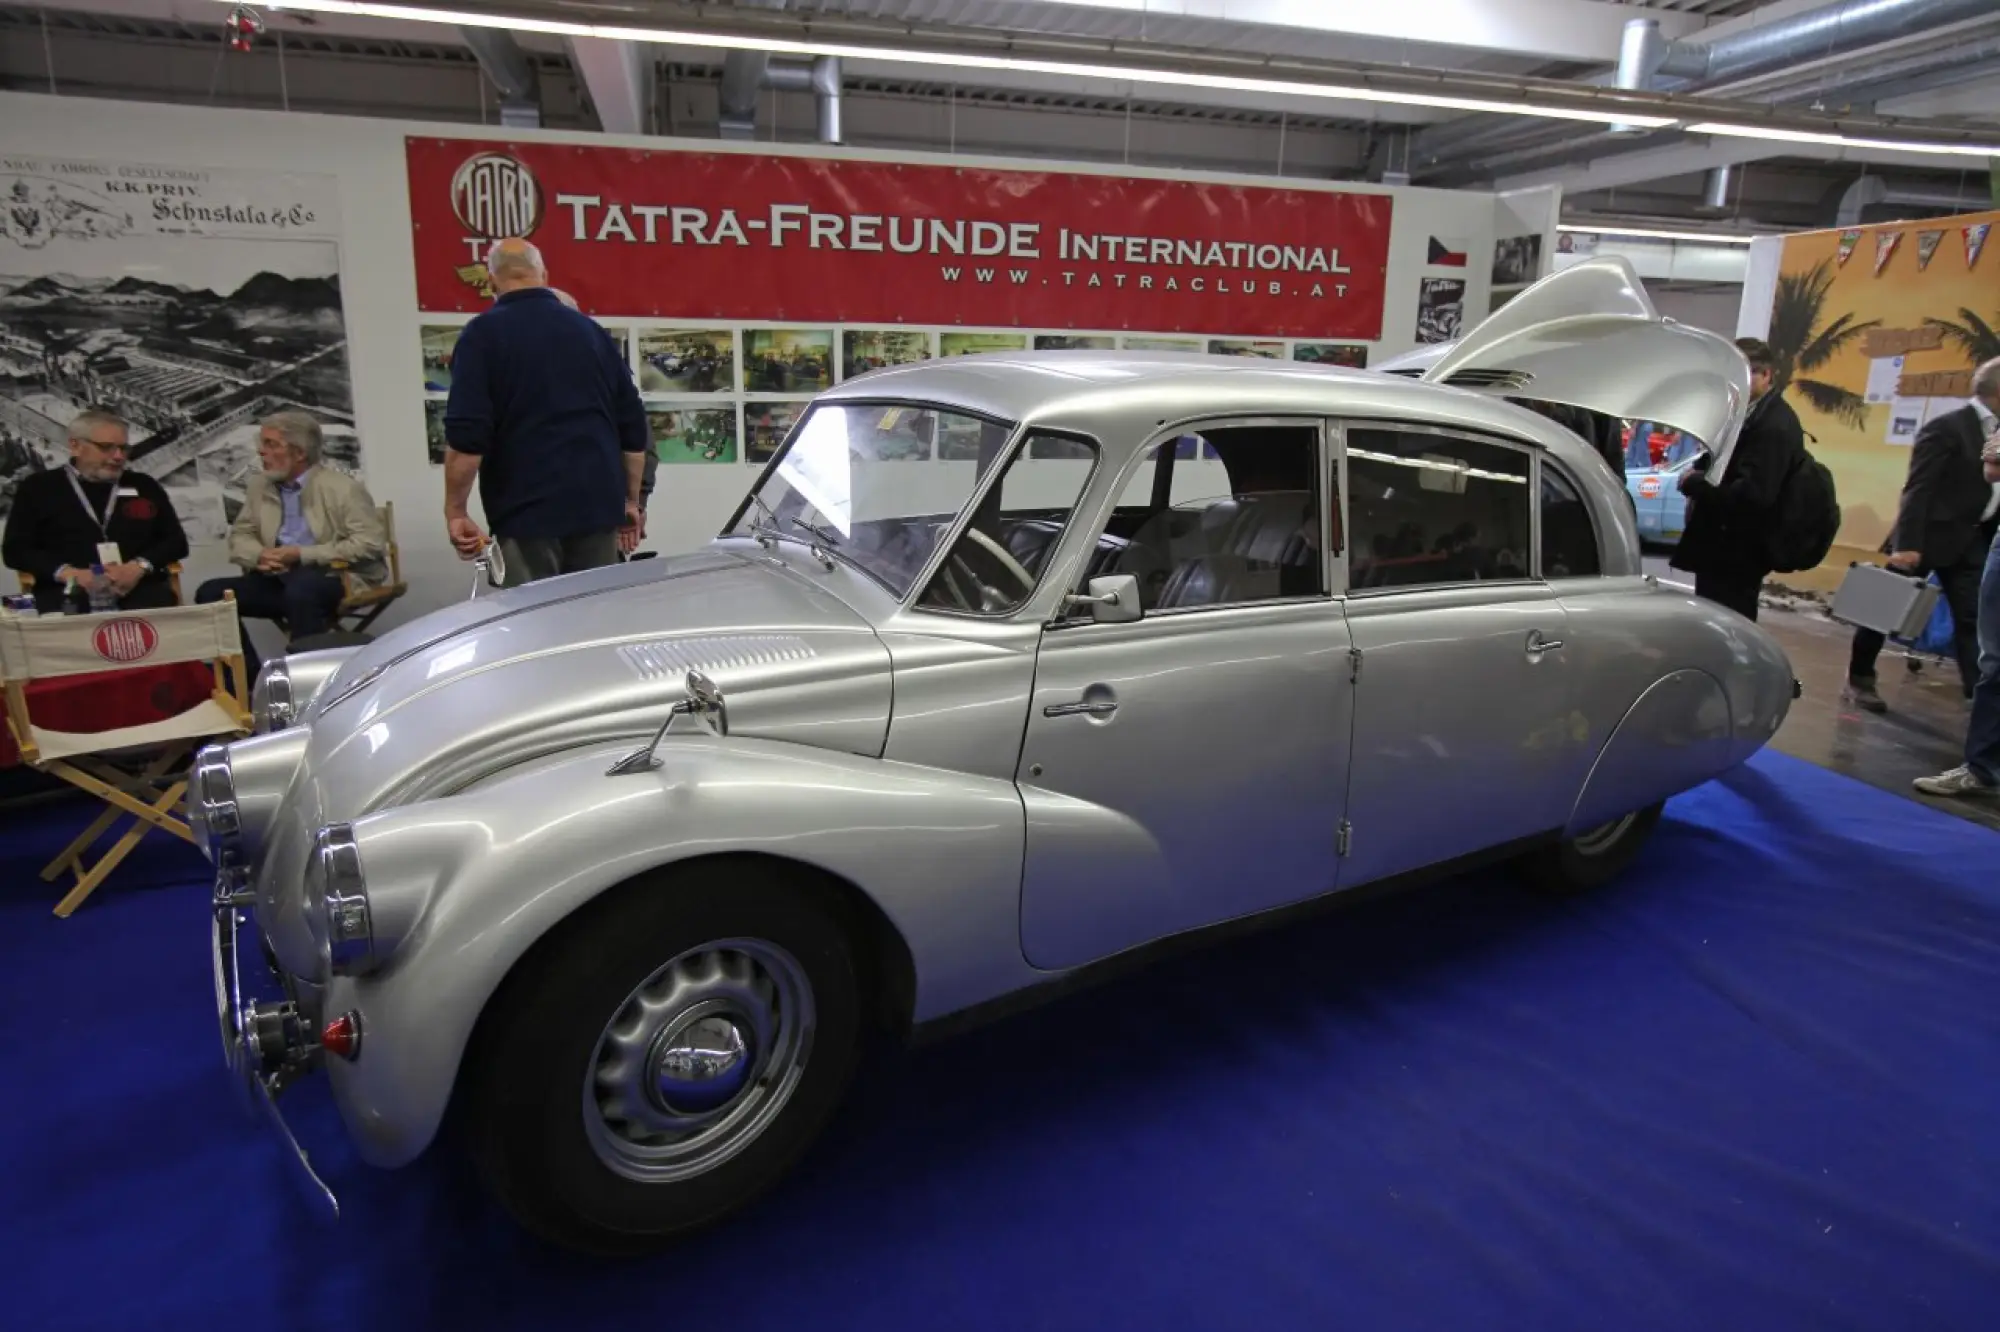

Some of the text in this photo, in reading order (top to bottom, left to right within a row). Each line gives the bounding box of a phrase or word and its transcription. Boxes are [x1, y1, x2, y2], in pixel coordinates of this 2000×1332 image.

[456, 157, 535, 237] TATRA
[556, 193, 1351, 274] TATRA-FREUNDE INTERNATIONAL
[941, 266, 1348, 298] WWW.TATRACLUB.AT
